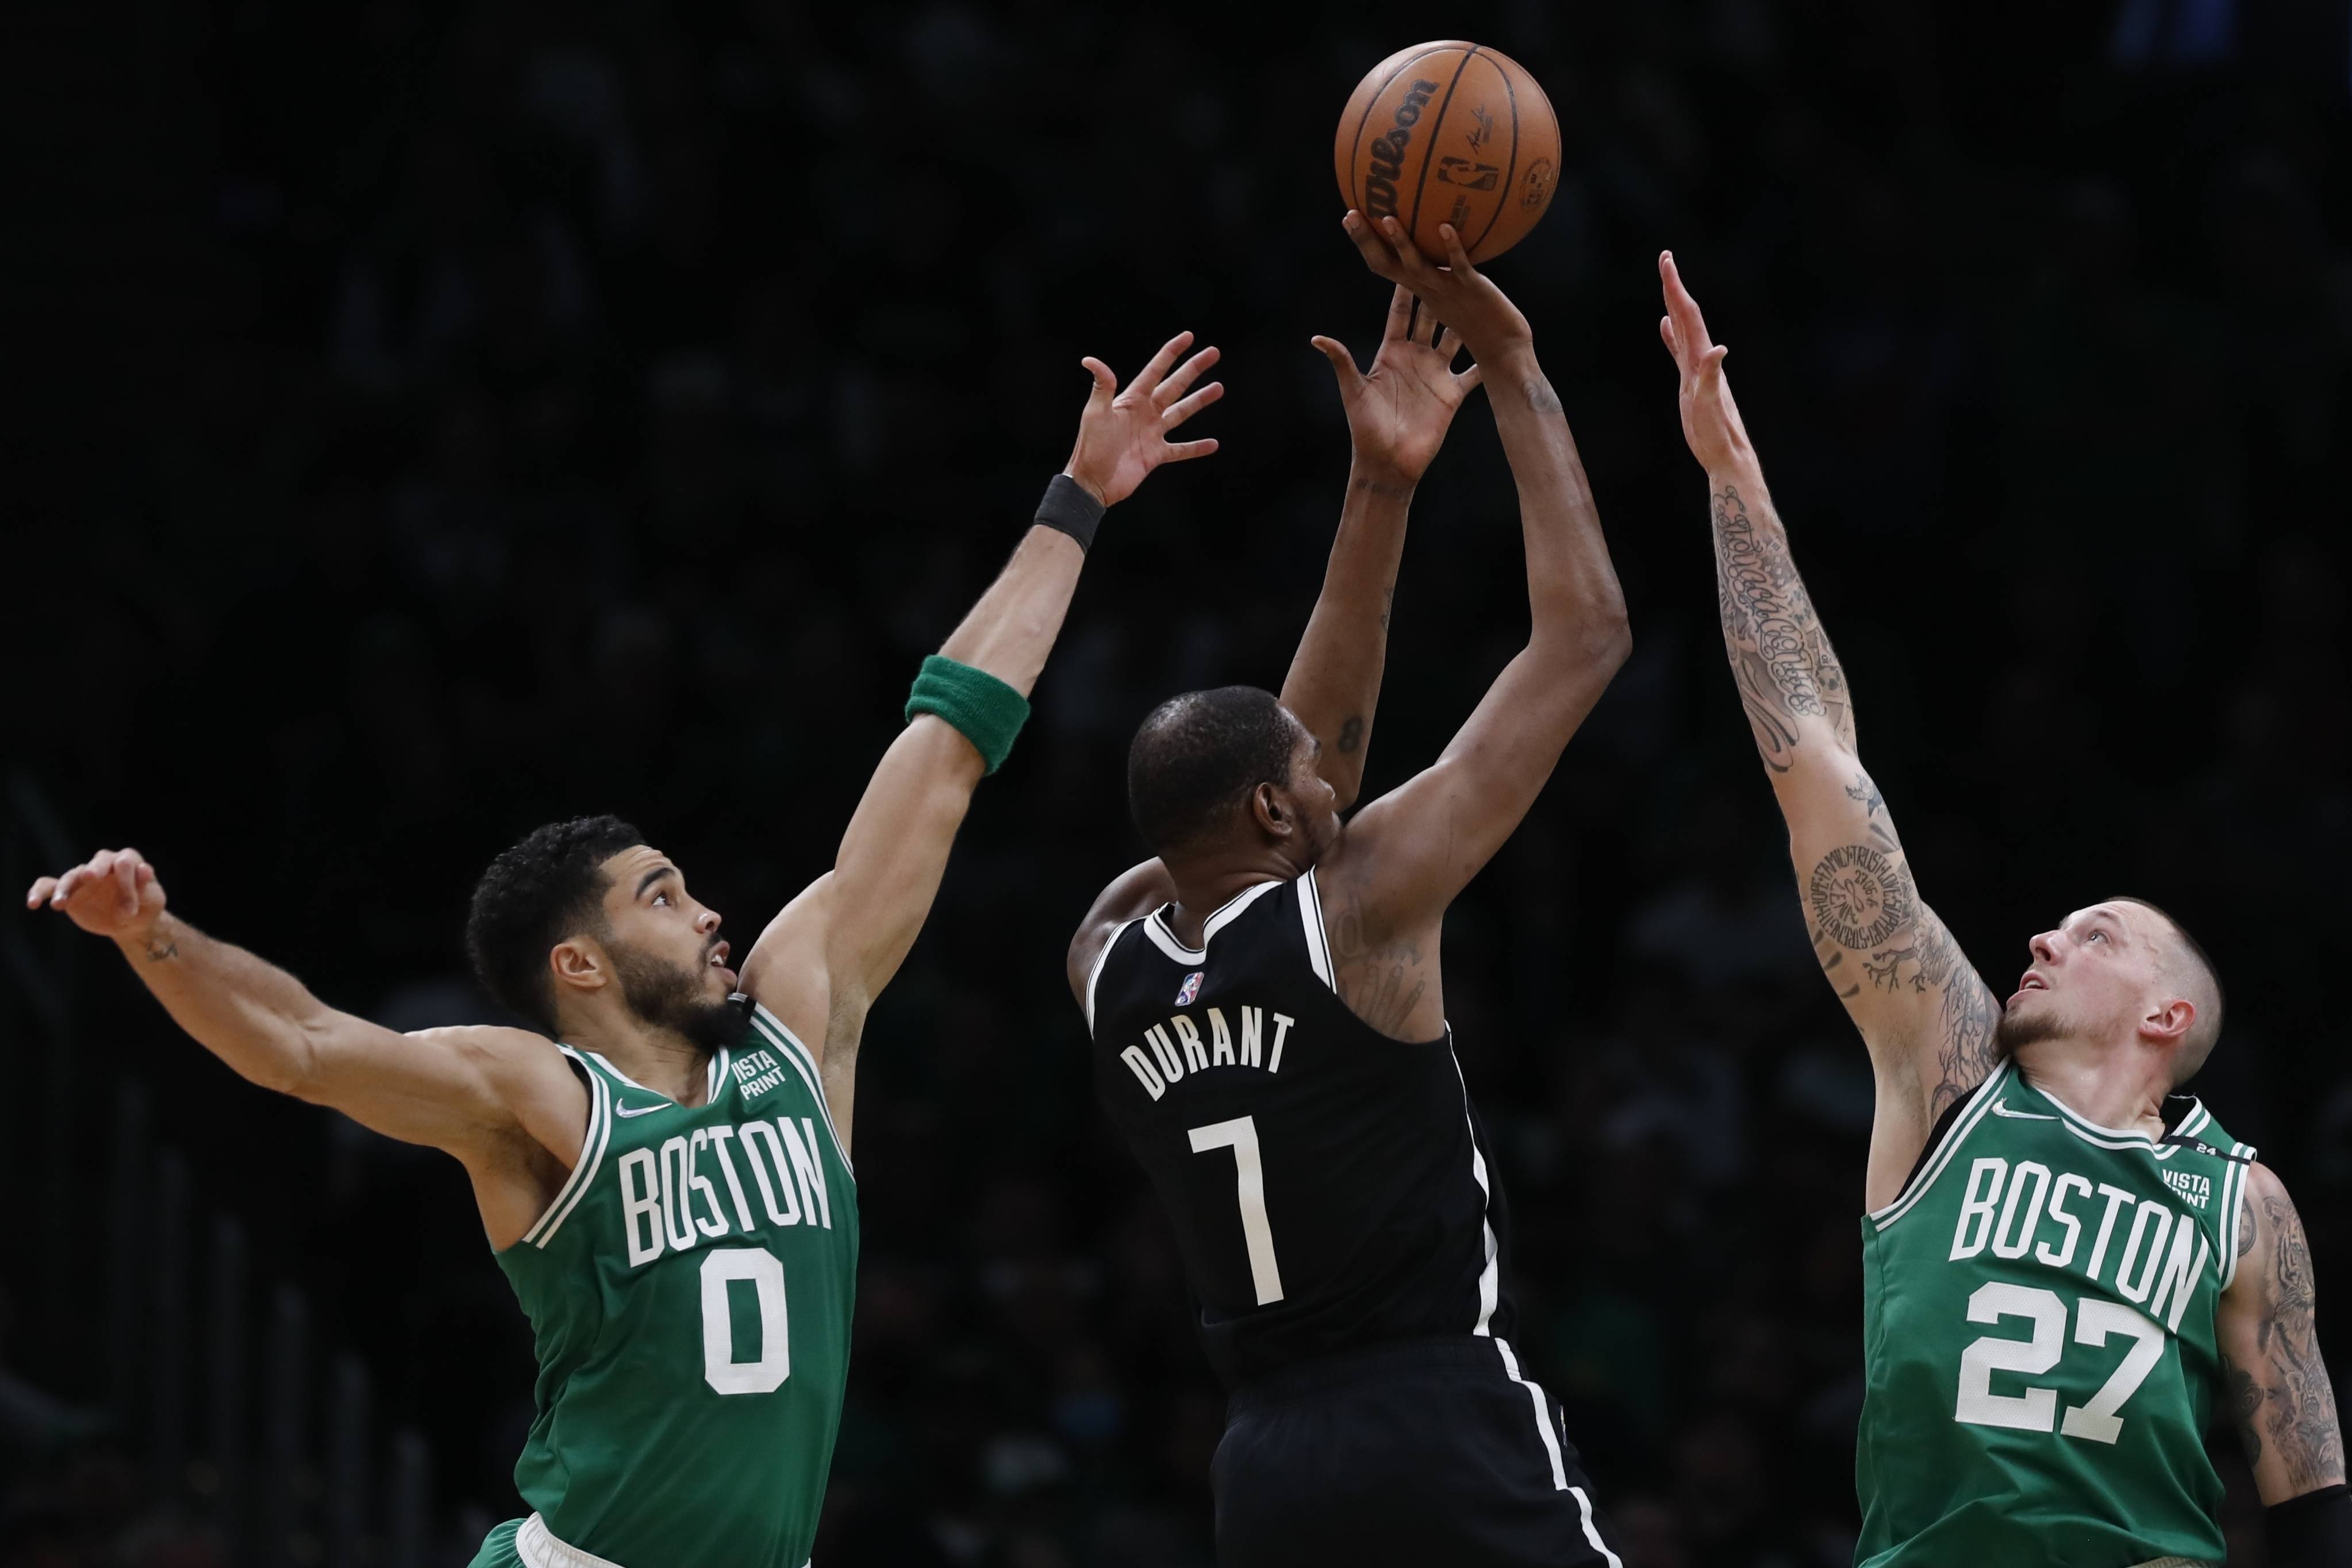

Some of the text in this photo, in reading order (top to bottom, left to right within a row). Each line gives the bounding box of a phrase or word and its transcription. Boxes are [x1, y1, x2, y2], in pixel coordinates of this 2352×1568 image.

[1365, 78, 1440, 219] Wilson
[740, 1066, 786, 1100] PRINT
[1120, 1005, 1295, 1102] DURANT
[618, 1116, 831, 1268] BOSTON
[1187, 1115, 1284, 1306] 7
[2162, 1169, 2210, 1196] VISTA
[2196, 1143, 2216, 1156] 24
[1949, 1157, 2209, 1335] BOSTON
[700, 1247, 790, 1396] 0
[1954, 1281, 2165, 1445] 27
